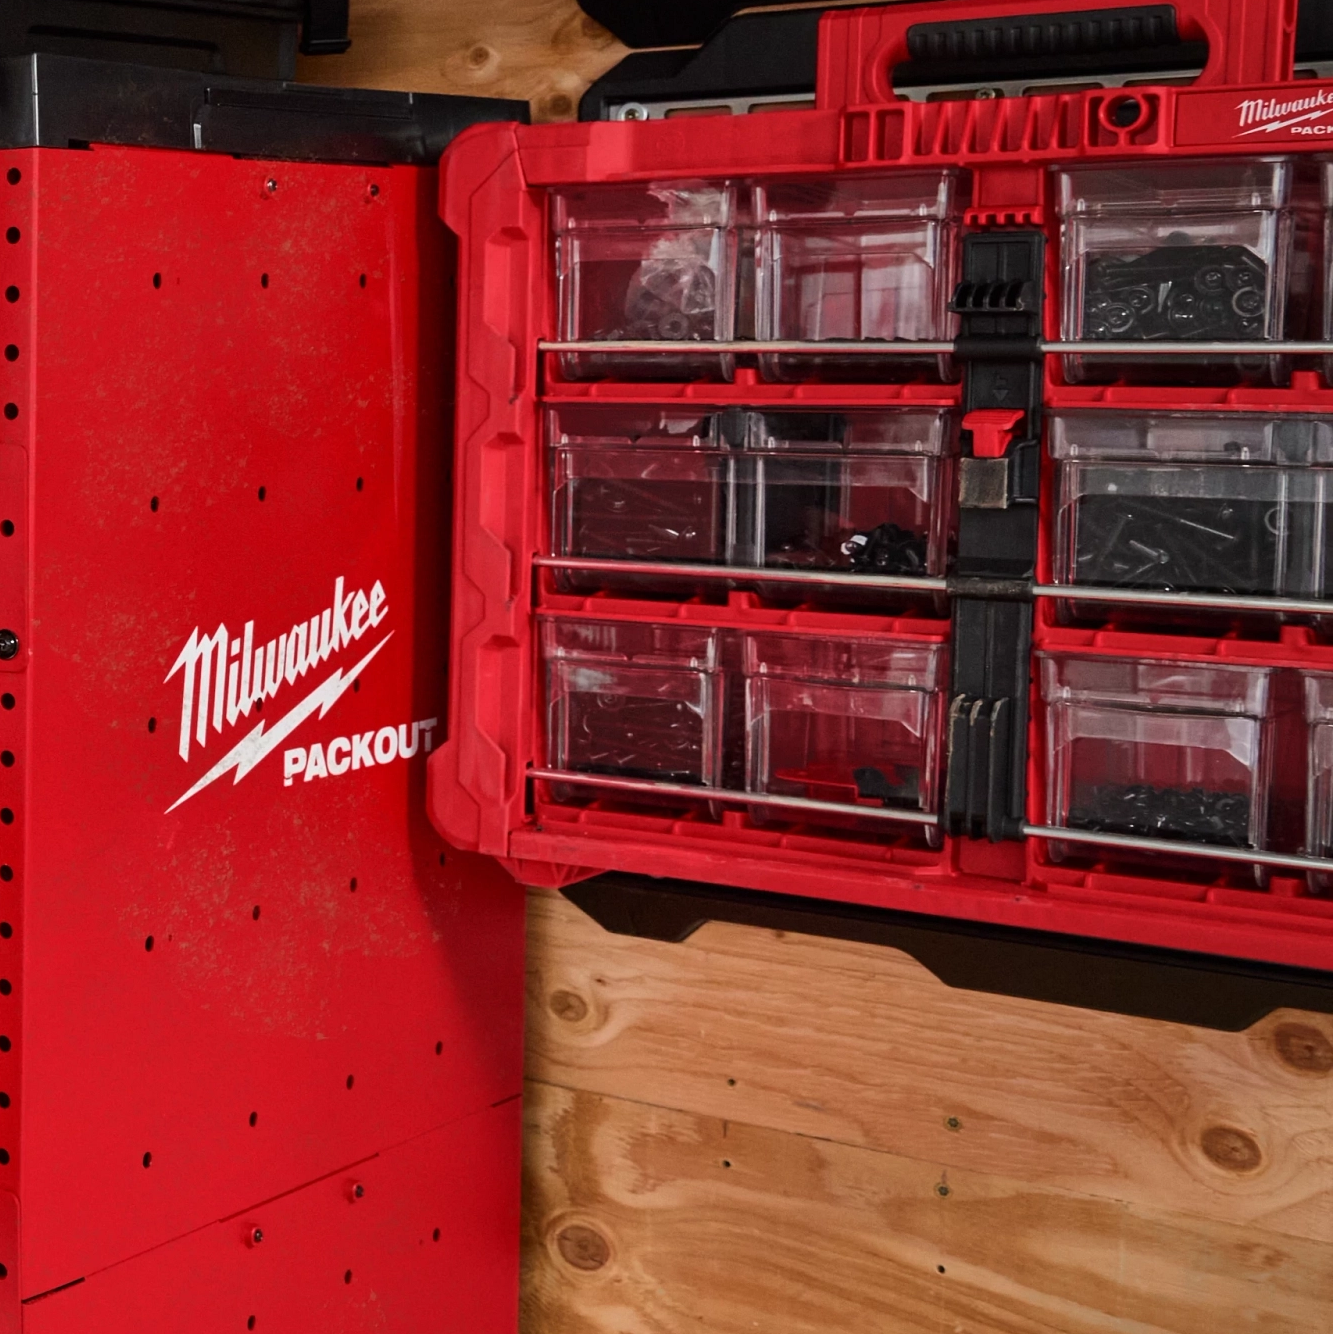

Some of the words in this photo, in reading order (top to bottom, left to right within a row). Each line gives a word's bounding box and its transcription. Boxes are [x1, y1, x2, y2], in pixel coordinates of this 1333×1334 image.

[1234, 89, 1333, 127] Milwauke
[163, 575, 389, 764] Milwaukee
[283, 717, 438, 787] PACKOUT
